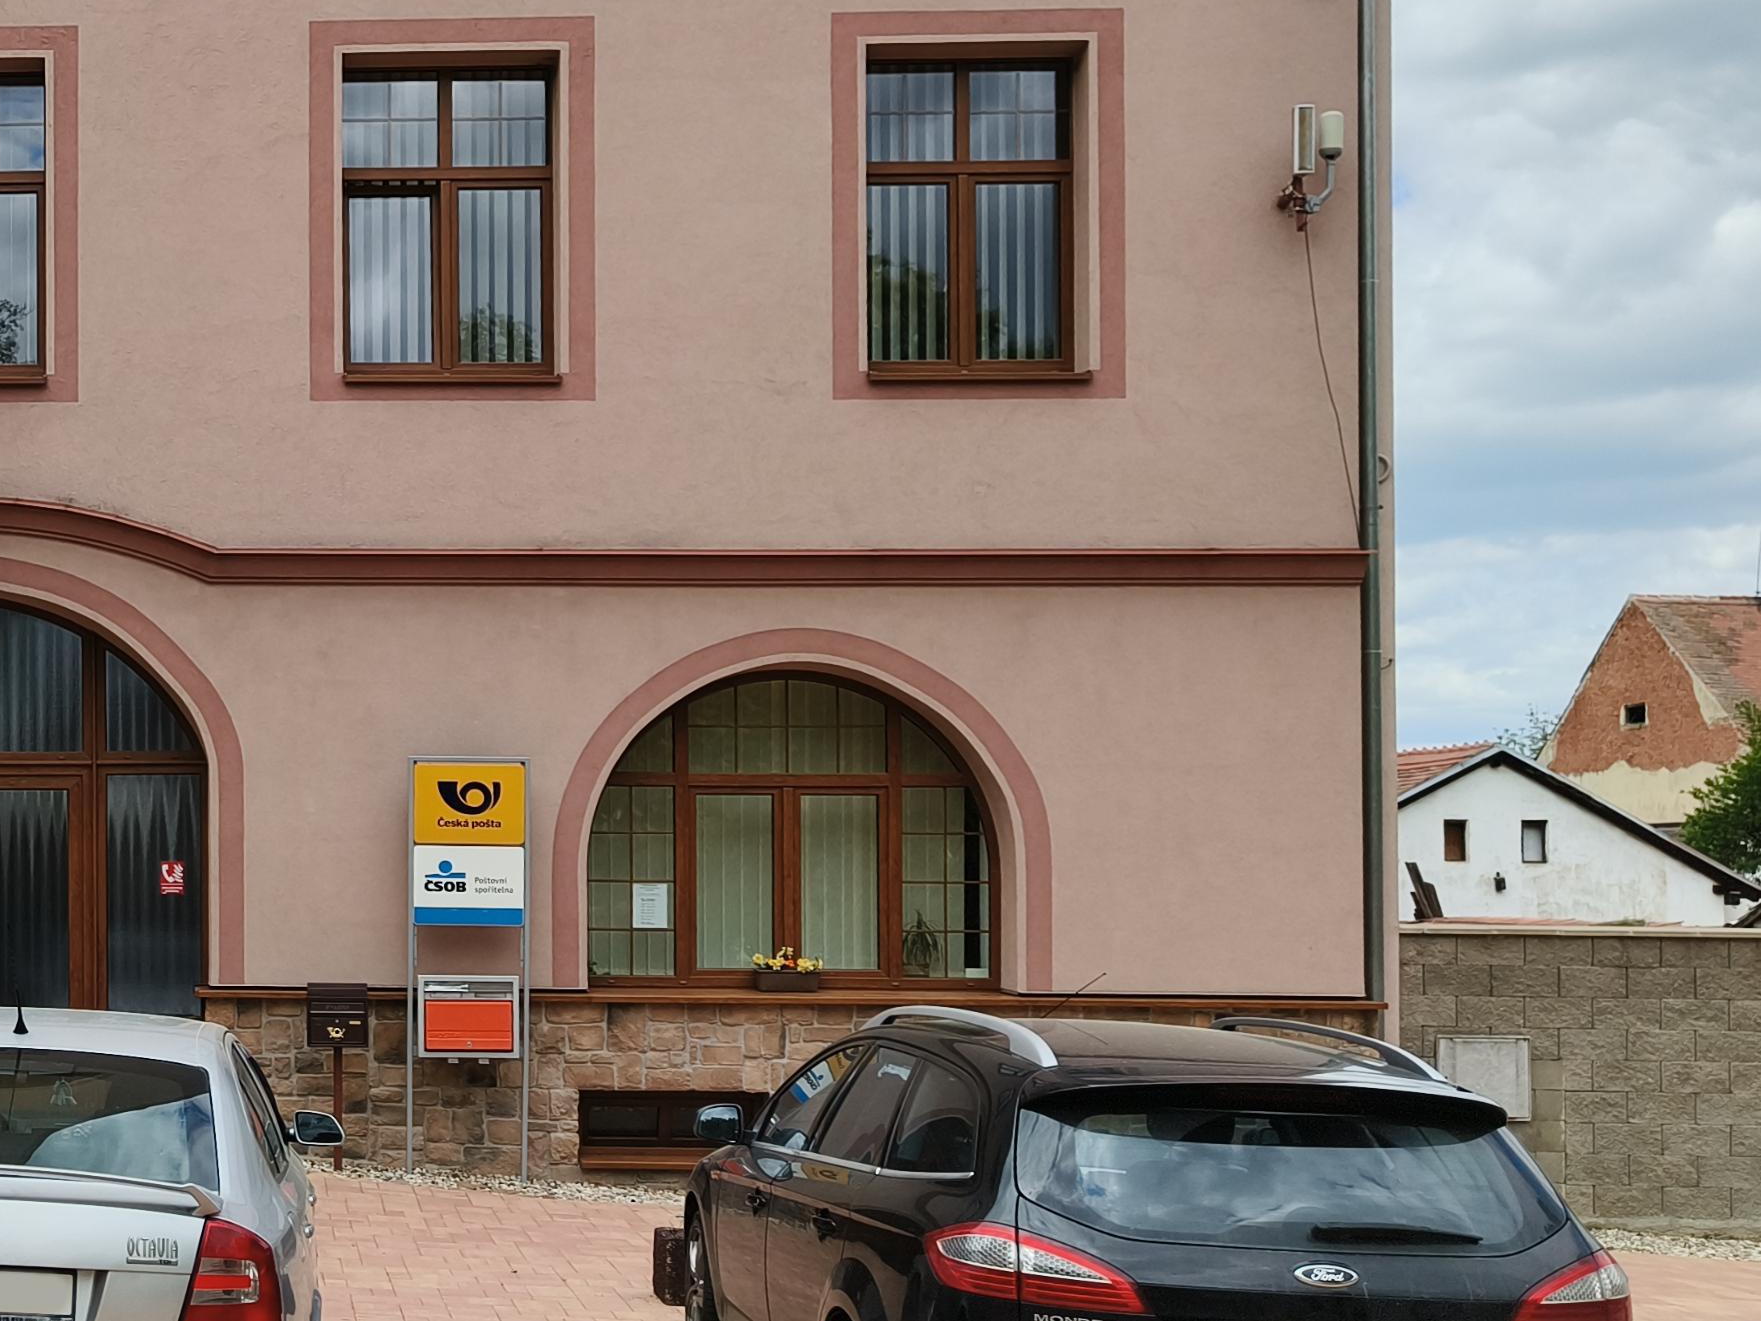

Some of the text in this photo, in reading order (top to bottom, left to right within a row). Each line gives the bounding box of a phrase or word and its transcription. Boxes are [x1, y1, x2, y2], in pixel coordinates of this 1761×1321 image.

[437, 817, 502, 829] Česká pošta
[424, 880, 467, 893] ČSOB
[474, 876, 508, 885] Poštovní
[474, 886, 514, 894] spořitelna
[126, 1238, 179, 1259] OCTAVIA
[1310, 1268, 1345, 1282] Ford
